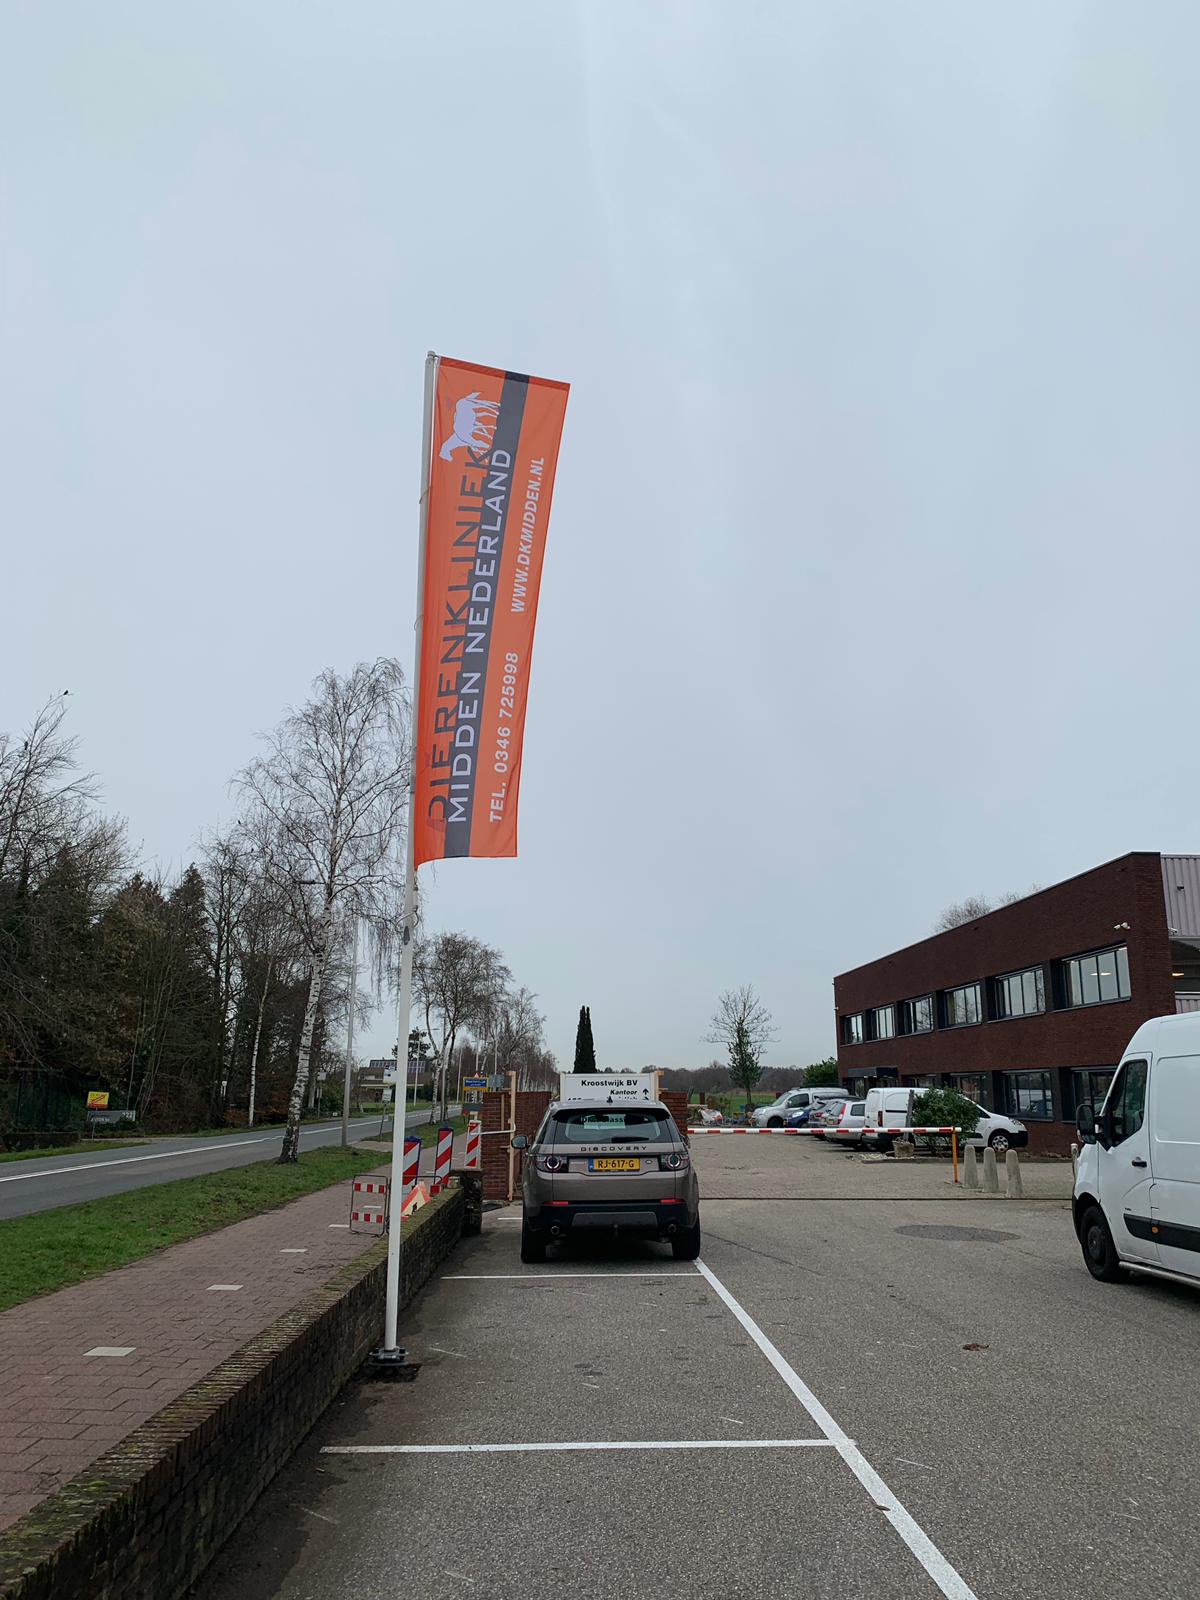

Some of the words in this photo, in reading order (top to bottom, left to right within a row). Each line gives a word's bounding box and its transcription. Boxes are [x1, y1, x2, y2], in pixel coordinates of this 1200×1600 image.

[511, 457, 545, 613] WWW.DKMIDDEN.NL
[448, 672, 481, 823] MIDDEN
[465, 449, 511, 653] NEDERLAND
[499, 652, 519, 719] 725998
[494, 726, 512, 773] 0346
[489, 782, 507, 823] TEL.
[581, 1079, 624, 1088] Kroostwijk
[626, 1079, 638, 1087] BV
[597, 1159, 635, 1169] RJ-617-G
